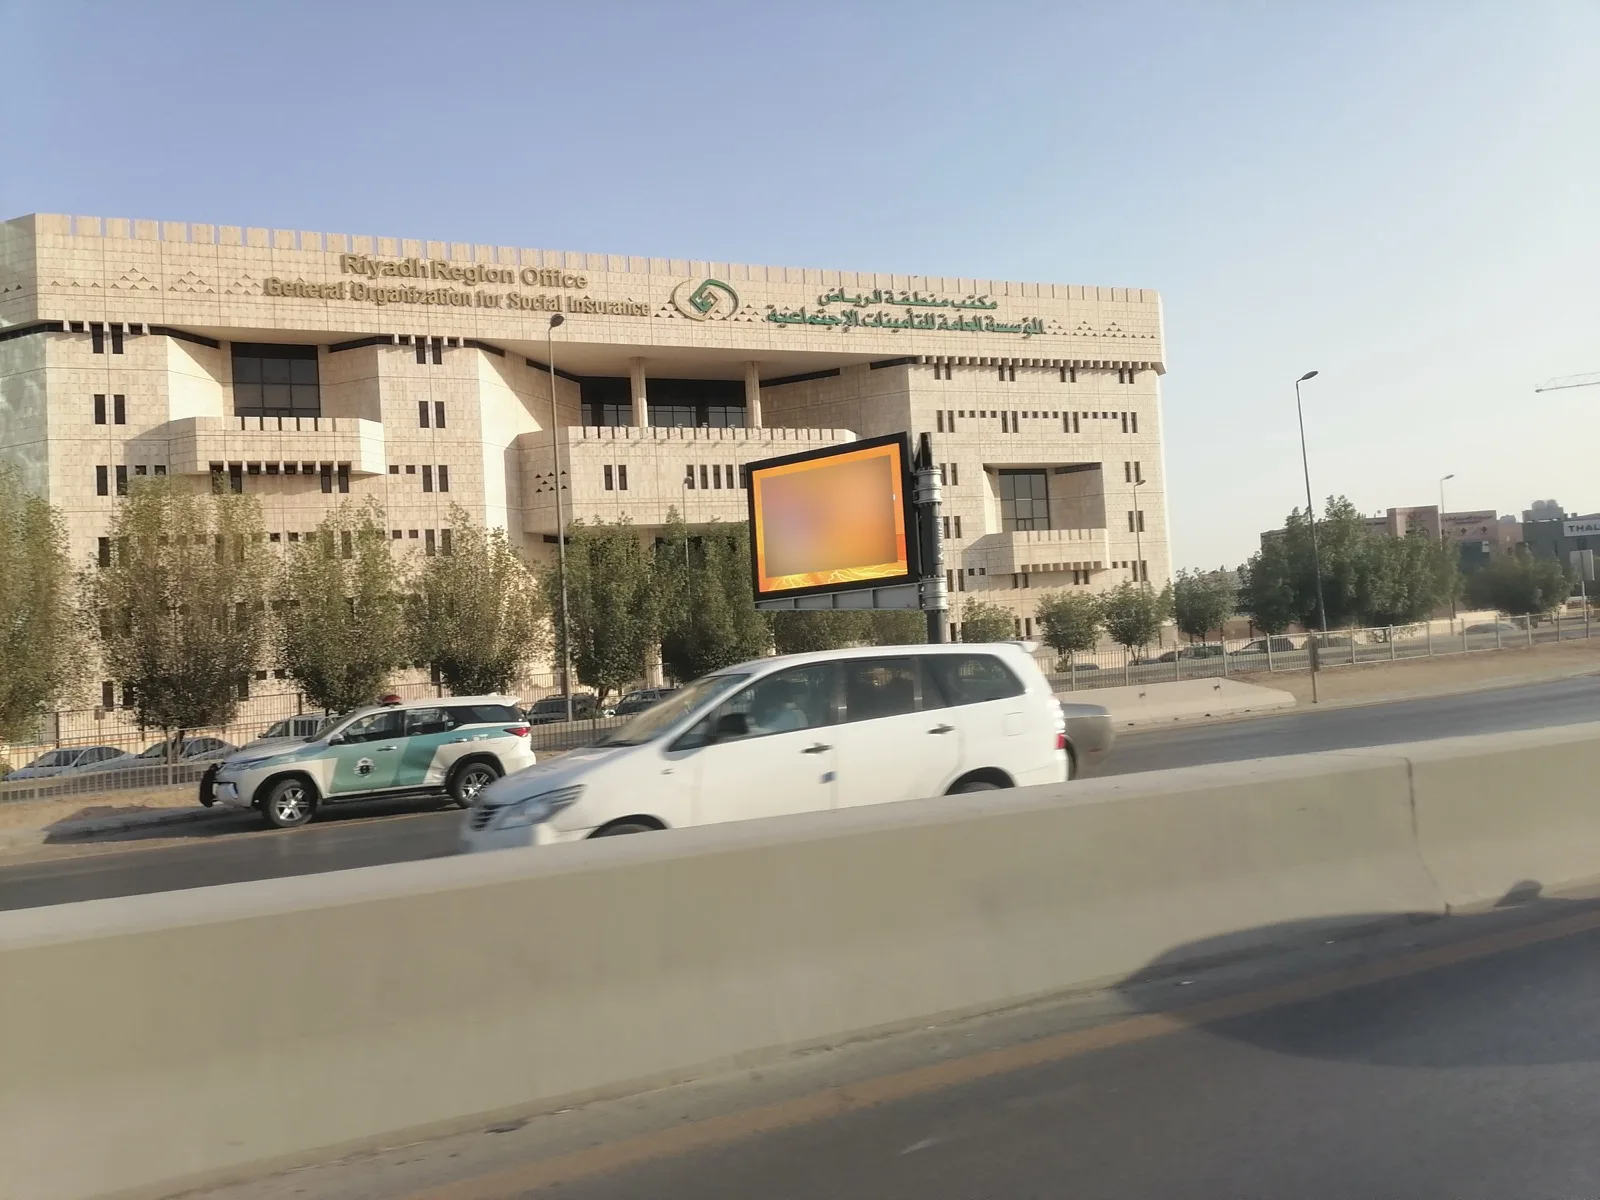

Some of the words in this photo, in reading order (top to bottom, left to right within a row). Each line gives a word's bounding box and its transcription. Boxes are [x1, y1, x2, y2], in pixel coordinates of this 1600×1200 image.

[339, 253, 429, 280] Riyadh
[430, 259, 515, 286] Region
[521, 266, 588, 289] Office
[263, 276, 346, 300] General
[349, 281, 472, 307] Organization
[475, 289, 503, 309] for
[506, 290, 563, 312] Social
[566, 295, 651, 317] Insurance
[817, 286, 882, 308] الرياض
[883, 289, 949, 307] منطقة
[950, 294, 998, 312] مكتب
[861, 307, 936, 334] للتأمينات
[936, 312, 985, 332] العامة
[985, 314, 1045, 339] المؤسسة
